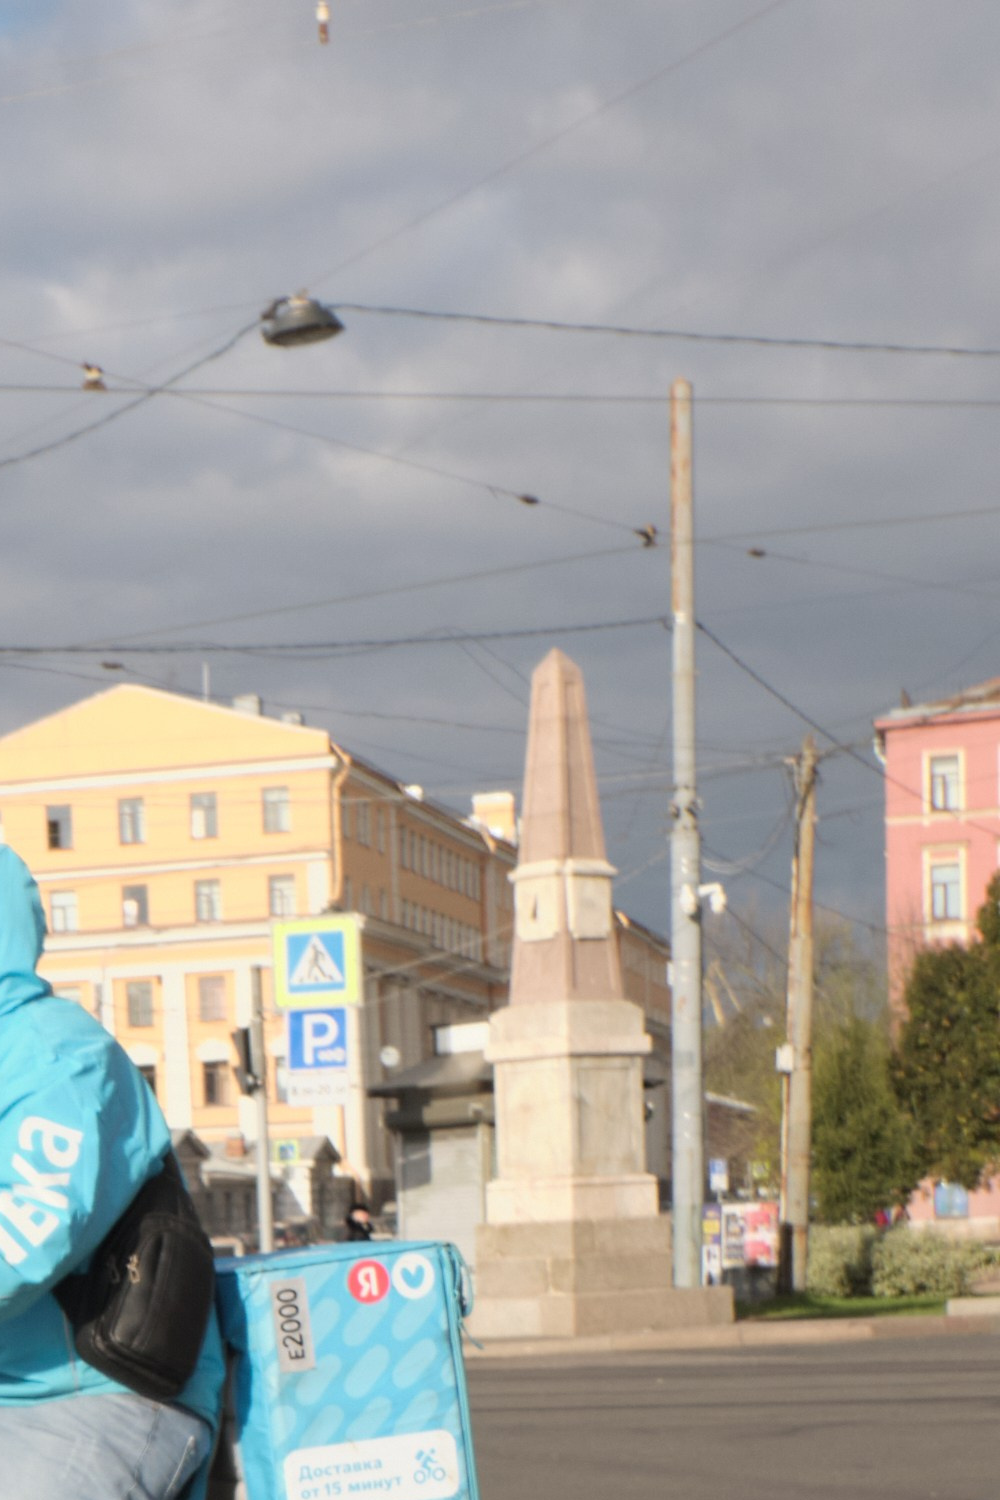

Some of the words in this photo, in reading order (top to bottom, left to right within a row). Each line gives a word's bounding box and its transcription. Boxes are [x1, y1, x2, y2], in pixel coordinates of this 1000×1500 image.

[357, 1266, 380, 1298] Я
[277, 1288, 305, 1361] E2000
[298, 1458, 383, 1483] Доставка
[300, 1485, 319, 1500] от
[324, 1482, 342, 1498] 15
[347, 1474, 402, 1494] минут
